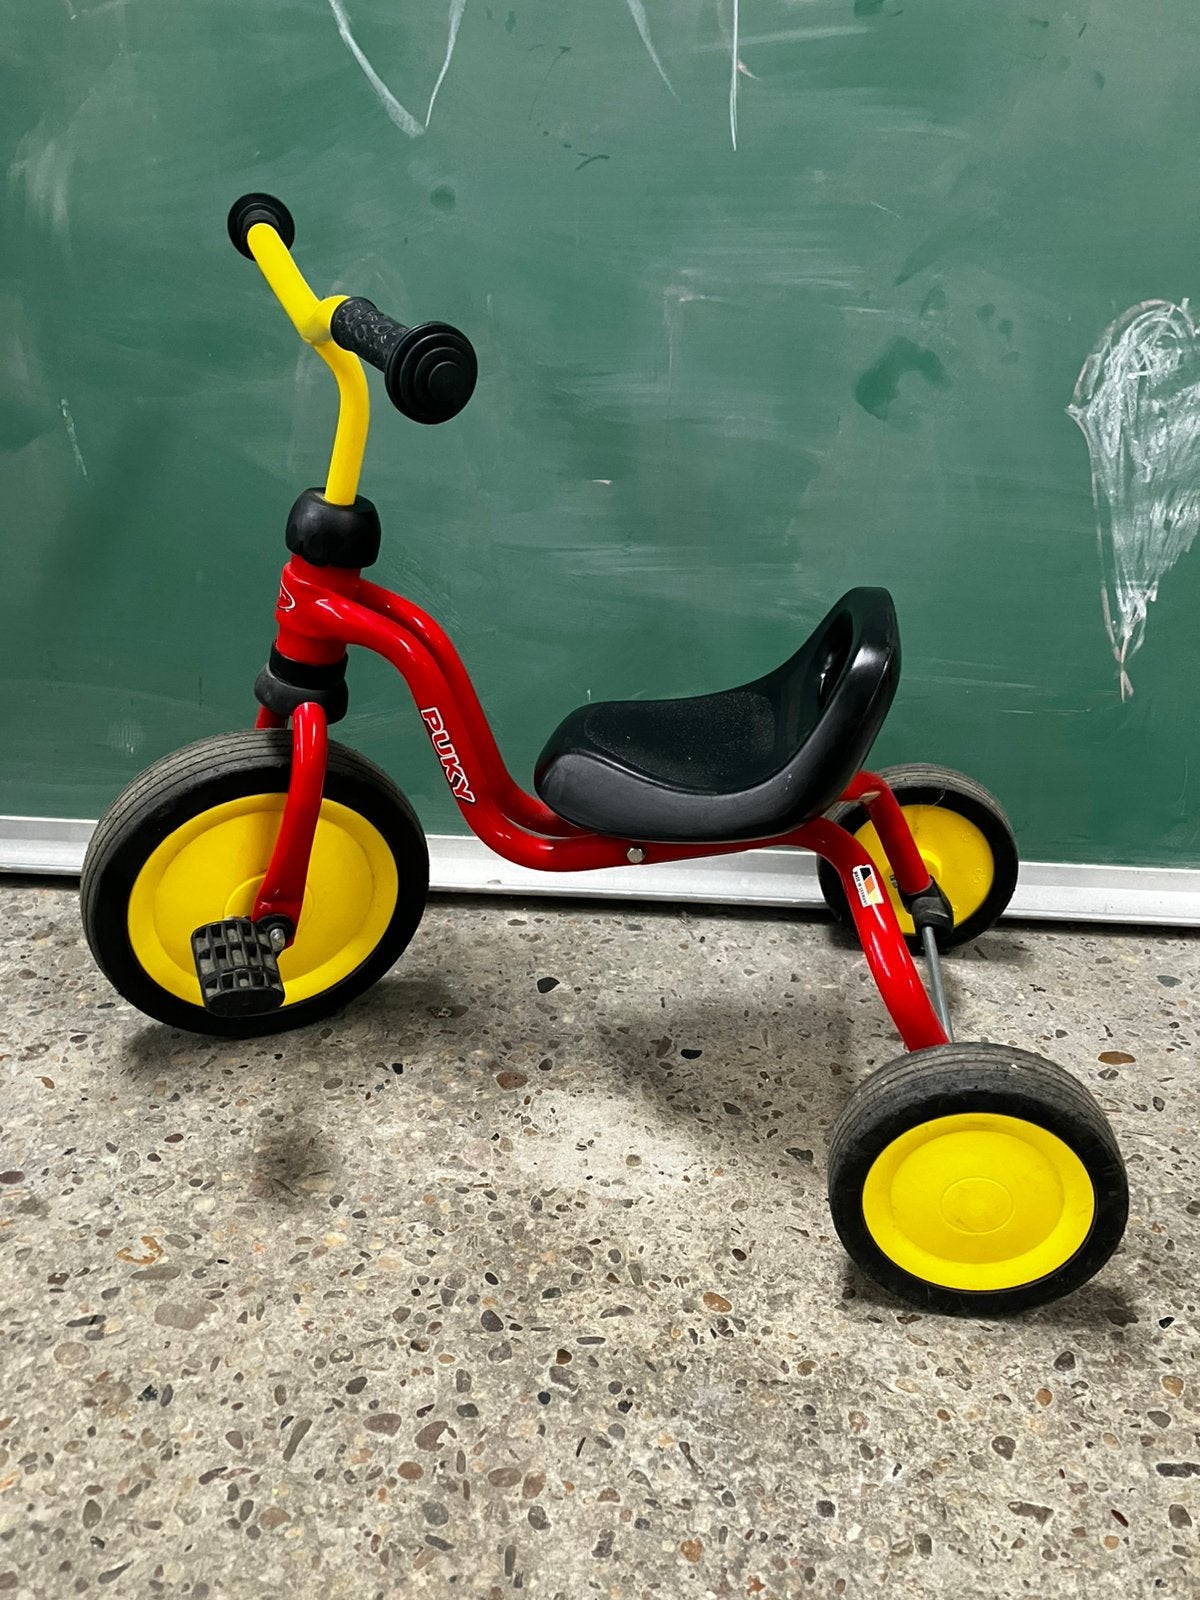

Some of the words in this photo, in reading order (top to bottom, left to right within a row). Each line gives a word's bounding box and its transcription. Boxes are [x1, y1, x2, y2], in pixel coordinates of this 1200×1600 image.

[421, 707, 476, 803] PUKY
[853, 871, 861, 882] MADE
[859, 887, 868, 905] GERMANY
